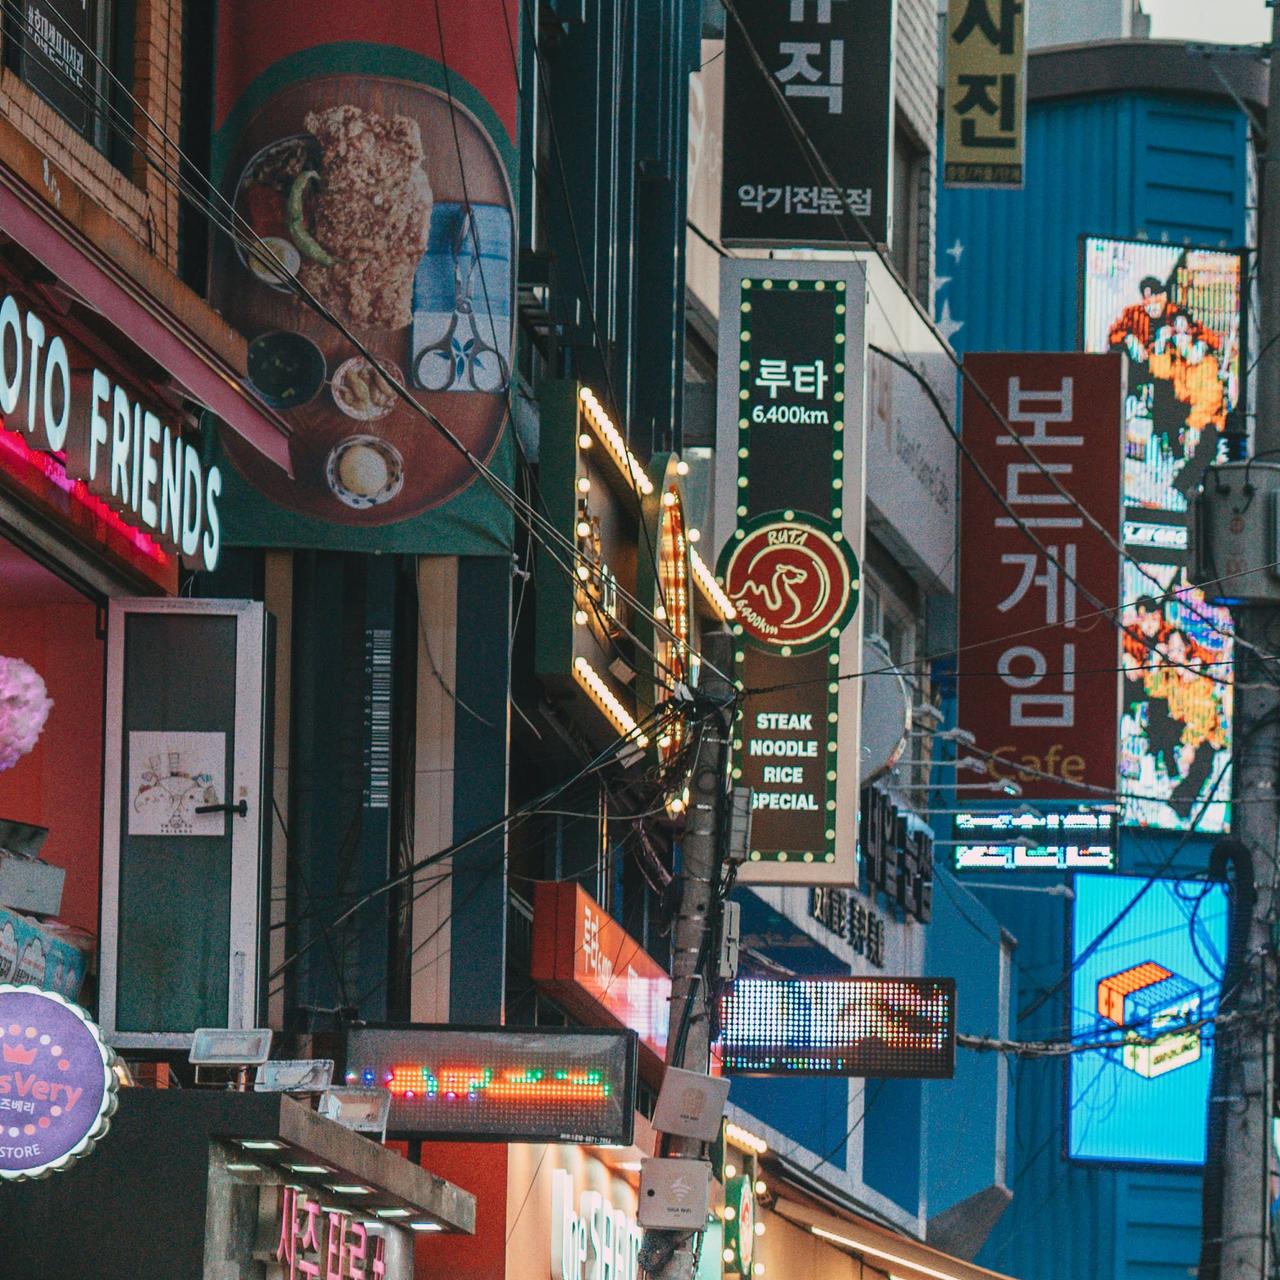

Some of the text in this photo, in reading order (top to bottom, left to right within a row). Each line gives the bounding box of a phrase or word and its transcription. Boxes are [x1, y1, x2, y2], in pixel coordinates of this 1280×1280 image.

[738, 184, 873, 217] 악기전문점
[755, 359, 829, 401] 루타
[89, 369, 222, 571] FRIENDS
[768, 529, 808, 546] RUTA
[995, 376, 1086, 728] 보드게임
[756, 713, 813, 731] STEAK
[749, 740, 818, 758] NOODLE
[763, 766, 804, 784] RICE
[989, 745, 1085, 783] Cafe
[753, 793, 819, 811] SPECIAL
